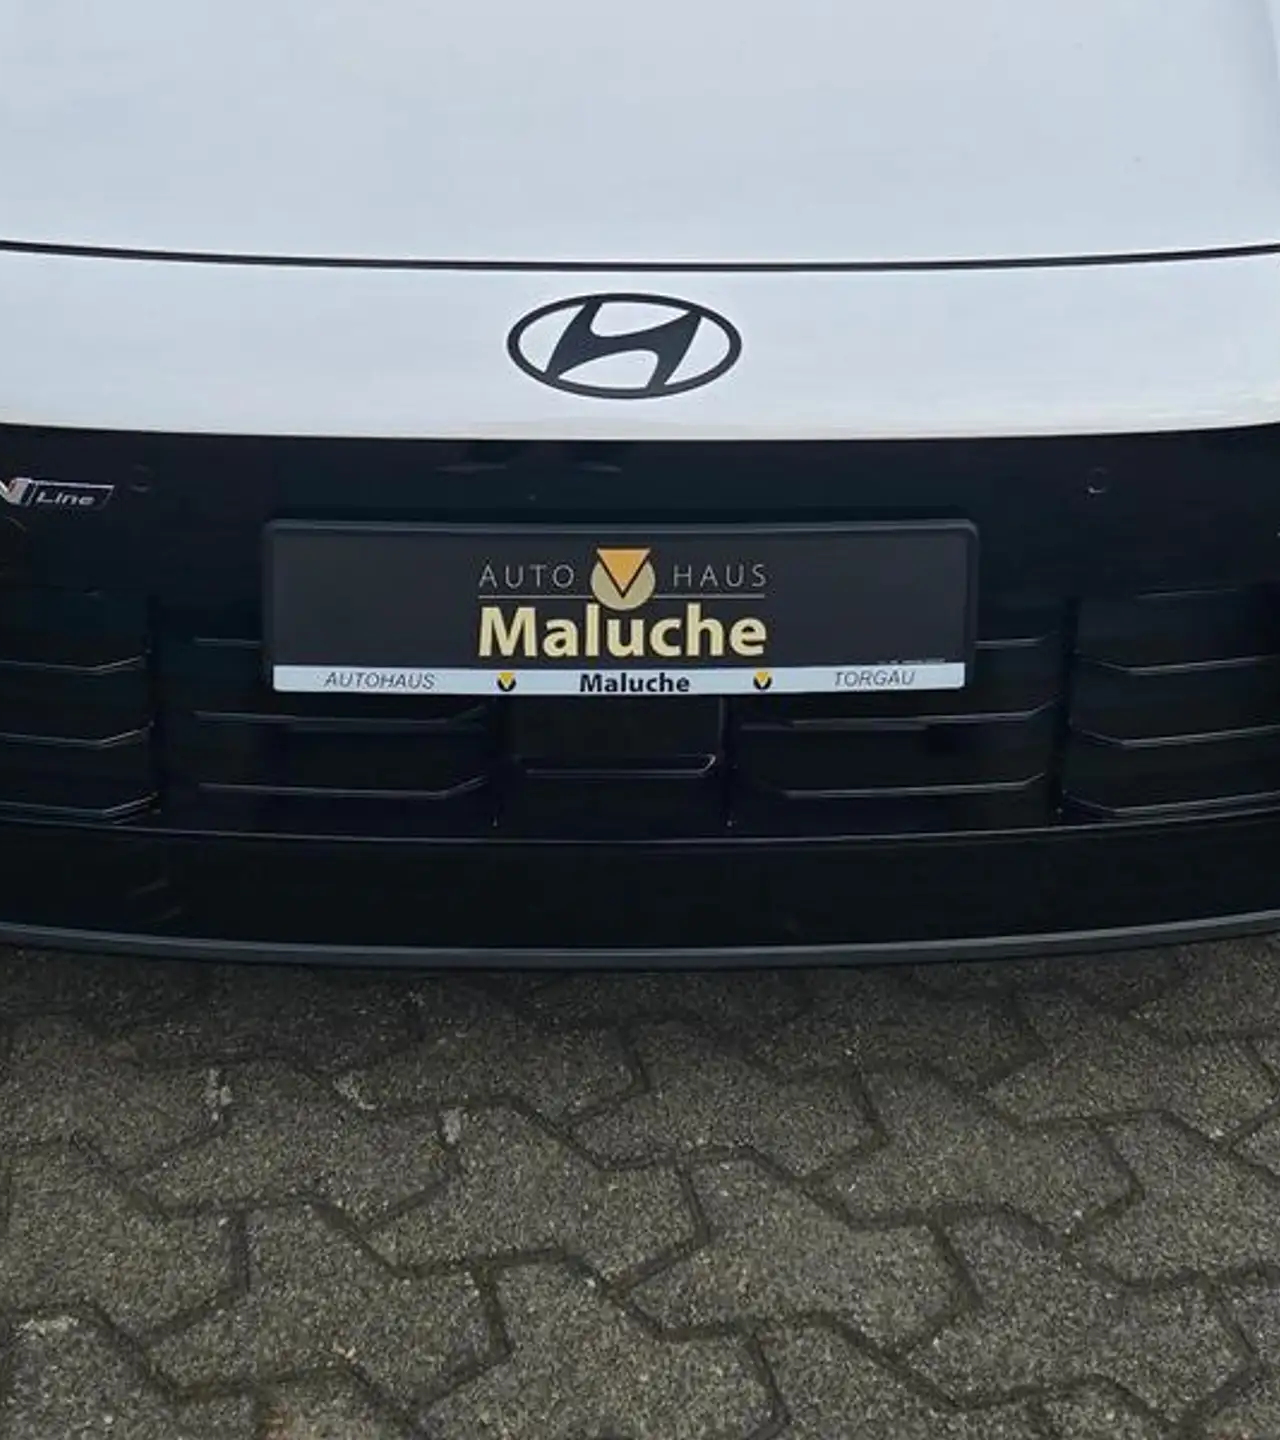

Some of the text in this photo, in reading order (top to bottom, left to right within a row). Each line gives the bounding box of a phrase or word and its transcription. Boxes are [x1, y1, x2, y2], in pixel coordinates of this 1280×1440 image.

[35, 490, 96, 506] Line
[478, 563, 767, 590] AUTO HAUS
[478, 602, 768, 658] Maluche
[322, 671, 436, 690] AUTOHAUS
[579, 672, 691, 694] Maluche
[833, 669, 916, 687] TORGAU
